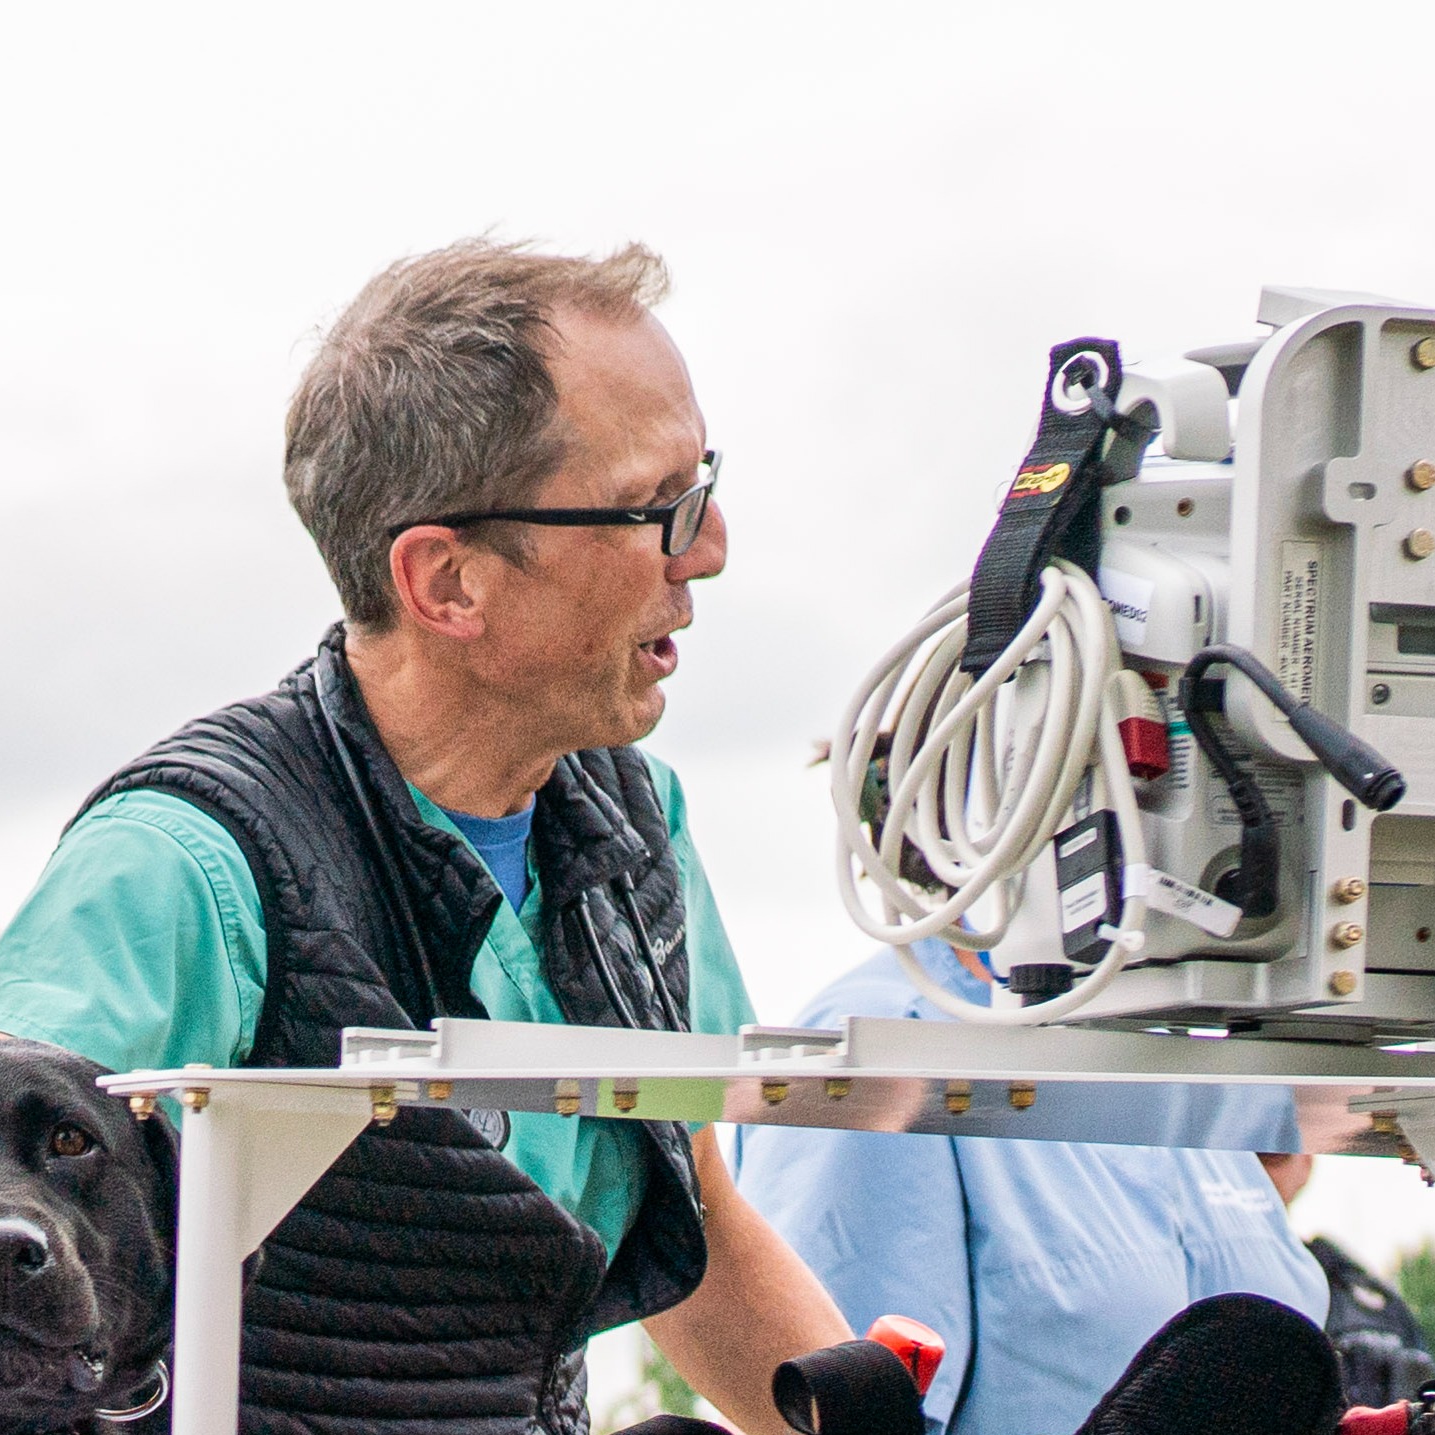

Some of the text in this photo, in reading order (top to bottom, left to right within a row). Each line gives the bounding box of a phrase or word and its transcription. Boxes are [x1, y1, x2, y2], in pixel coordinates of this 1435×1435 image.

[1304, 560, 1318, 635] SPECTRUM
[1281, 602, 1291, 648] NUMBER
[1291, 618, 1302, 665] NUMBER
